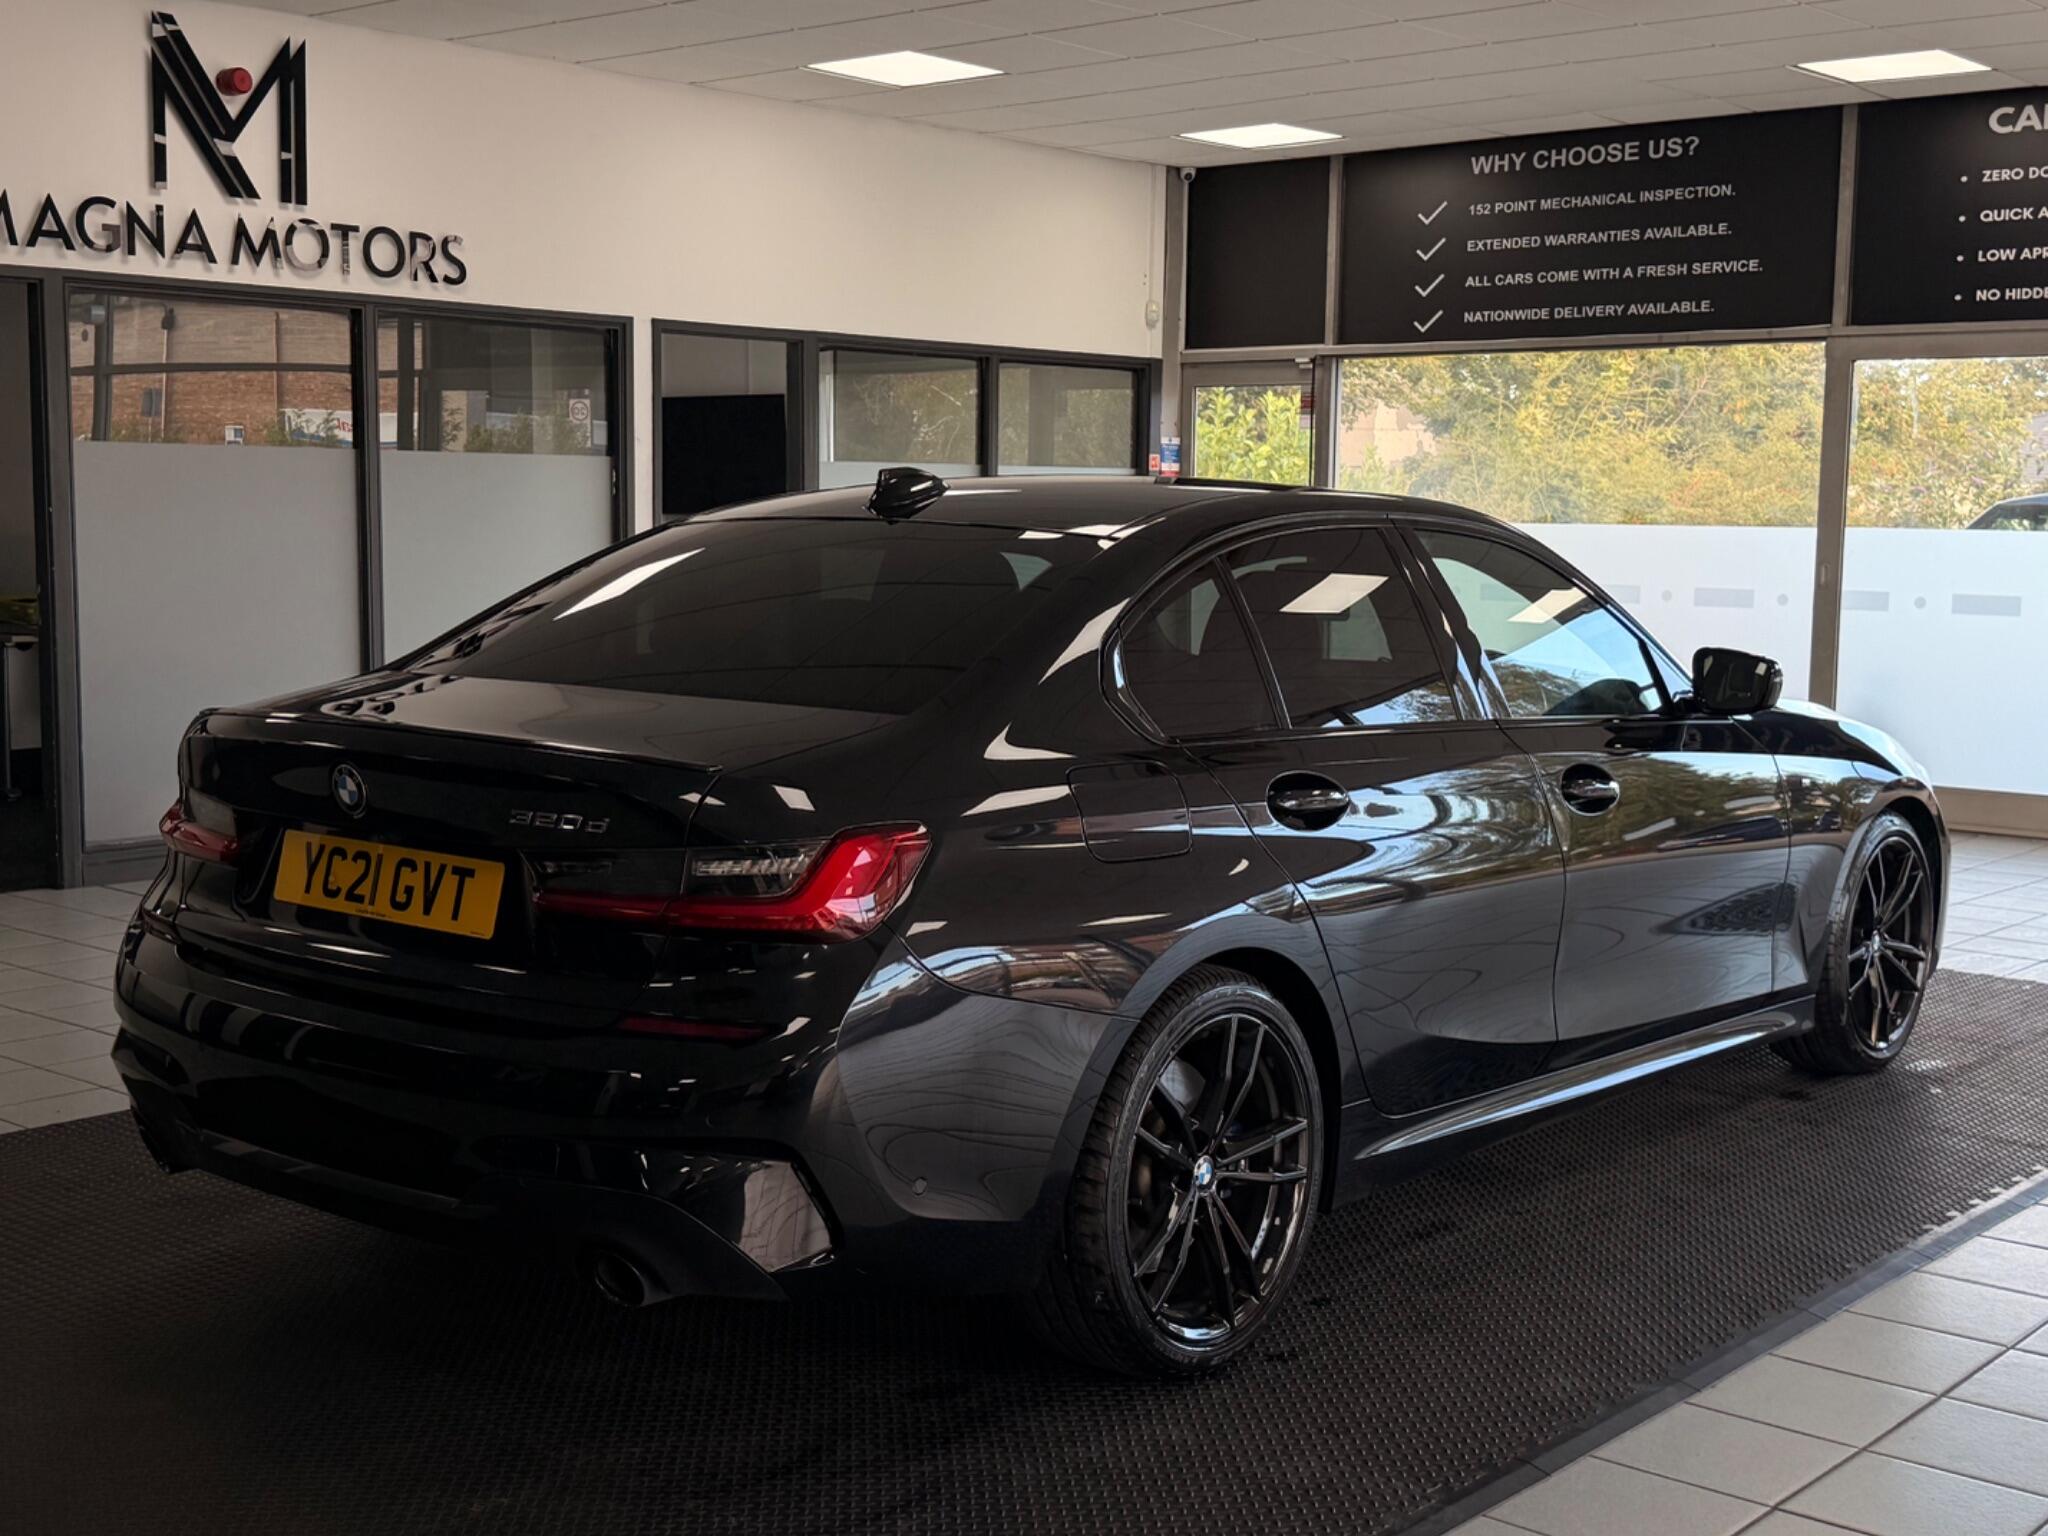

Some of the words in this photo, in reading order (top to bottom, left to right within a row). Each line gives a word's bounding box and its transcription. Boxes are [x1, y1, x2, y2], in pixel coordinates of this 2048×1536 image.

[1988, 103, 2048, 134] CA
[1471, 152, 1527, 175] WHY
[1532, 141, 1640, 170] CHOOSE
[1648, 136, 1700, 159] US?
[1982, 167, 2025, 183] ZERO
[1468, 203, 1491, 216] 152
[1494, 199, 1537, 214] POINT
[1540, 192, 1636, 211] MECHANICAL
[1639, 184, 1736, 203] INSPECTION.
[1979, 206, 2034, 222] QUICK
[231, 212, 468, 286] MOTORS
[1466, 236, 1541, 252] EXTENDED
[1544, 229, 1641, 247] WARRANTIES
[1643, 223, 1732, 241] AVAILABLE.
[1977, 248, 2017, 262] LOW
[1465, 276, 1492, 288] ALL
[1495, 273, 1534, 286] CARS
[1537, 270, 1580, 284] COME
[1582, 267, 1620, 281] WITH
[1622, 267, 1634, 279] A
[1637, 263, 1688, 278] FRESH
[1691, 259, 1763, 275] SERVICE.
[1976, 288, 2001, 302] NO
[1463, 307, 1550, 323] NATIONWIDE
[1553, 304, 1625, 320] DELIVERY
[1627, 300, 1715, 316] AVAILABLE.
[508, 809, 609, 834] 320d
[303, 840, 384, 908] YC21
[389, 856, 476, 922] GVT
